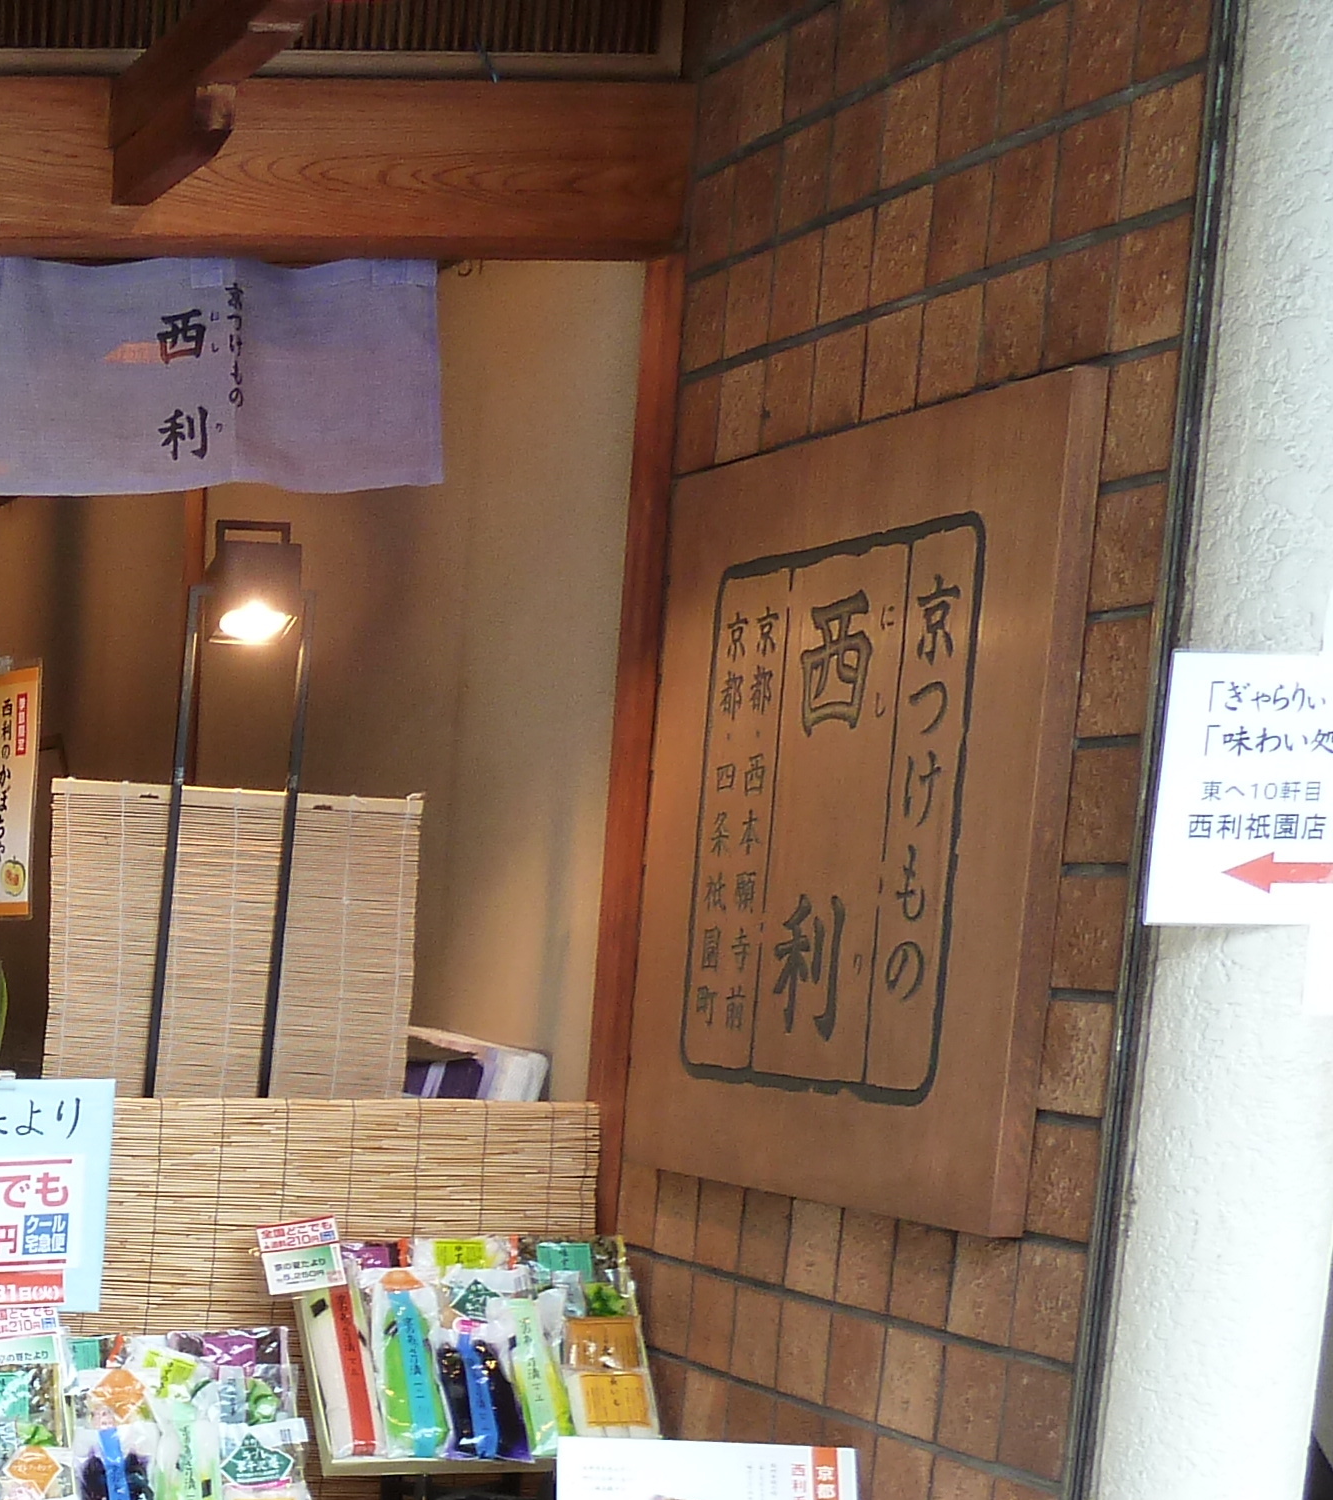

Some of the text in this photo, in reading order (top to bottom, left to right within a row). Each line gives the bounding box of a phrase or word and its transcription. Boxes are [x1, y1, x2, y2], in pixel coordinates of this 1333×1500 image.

[157, 308, 211, 462] 西利
[226, 282, 247, 408] 京つけもの
[695, 612, 749, 1028] 京都・四条祇園町
[725, 605, 780, 1036] 京都・西本願寺前
[774, 591, 874, 1044] 西利
[885, 574, 961, 1003] 京つけもの
[1187, 813, 1328, 841] 西利祇園店
[1200, 780, 1321, 803] 東へ10軒目
[24, 1233, 67, 1253] 宅急便
[25, 1214, 67, 1233] クール
[261, 1222, 332, 1240] 全国どこでも
